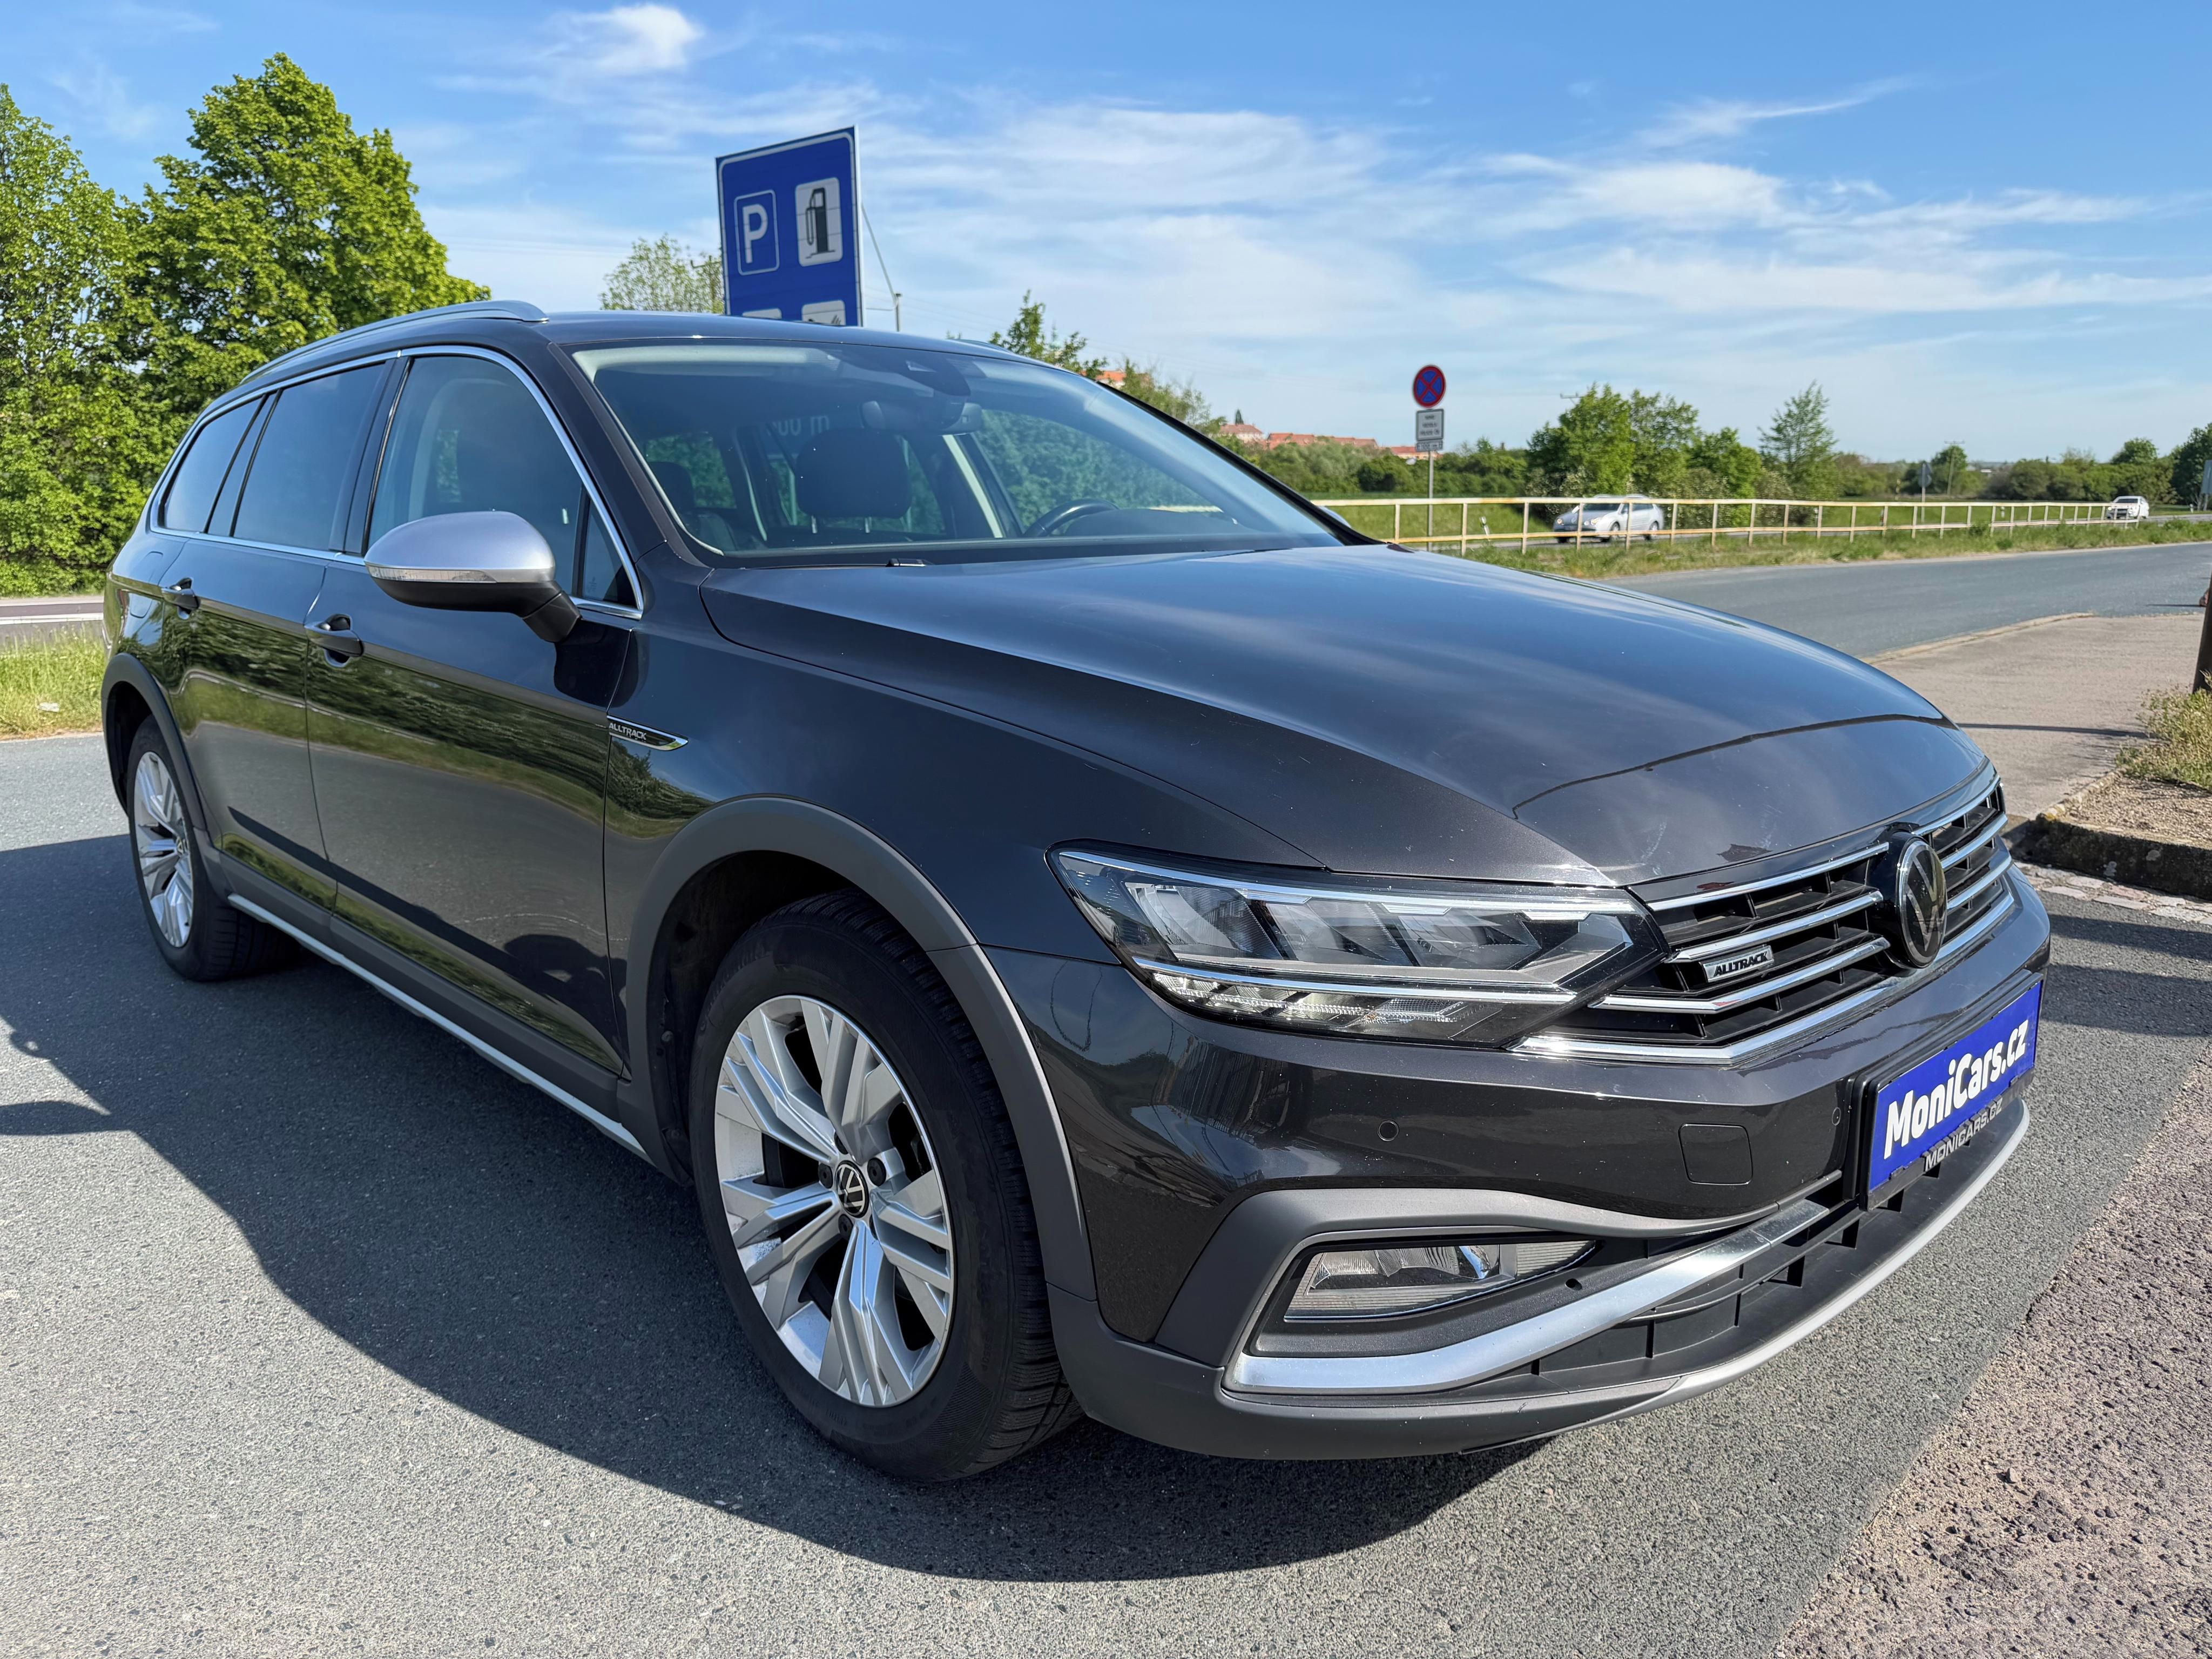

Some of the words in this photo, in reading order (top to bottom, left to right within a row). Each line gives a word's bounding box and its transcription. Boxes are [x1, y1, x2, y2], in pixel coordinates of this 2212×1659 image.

[742, 204, 768, 264] P
[609, 723, 647, 740] ALLTRACK
[1714, 951, 1768, 977] ALLTRACK
[1884, 1020, 2029, 1159] MoniCars.cz
[1925, 1097, 2003, 1171] MONICARS.CZ
